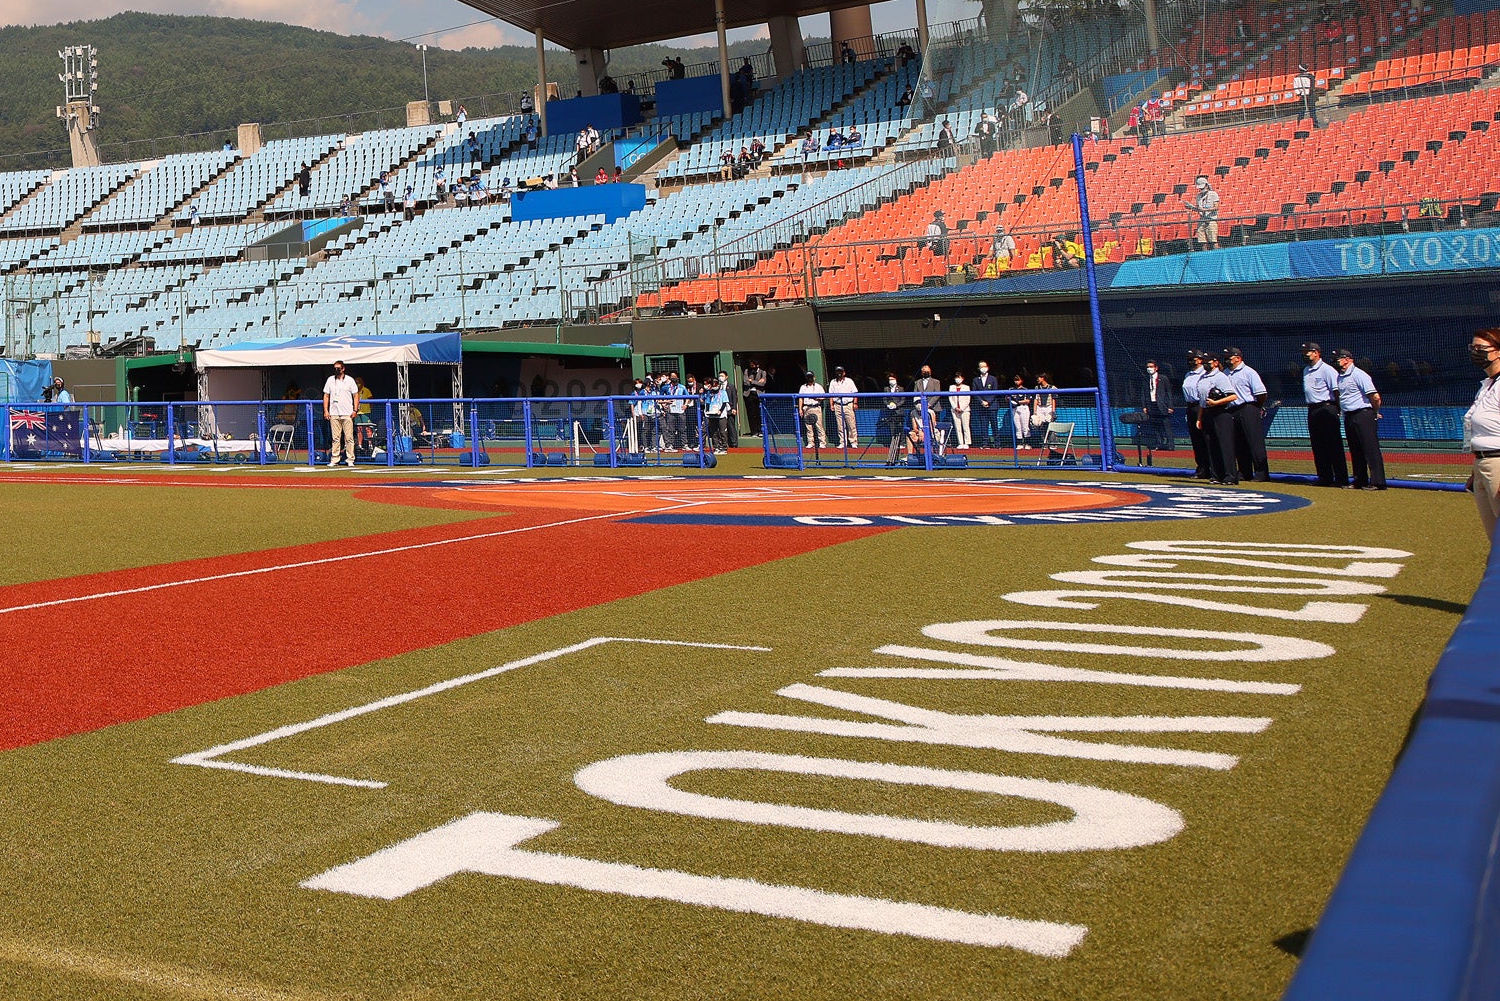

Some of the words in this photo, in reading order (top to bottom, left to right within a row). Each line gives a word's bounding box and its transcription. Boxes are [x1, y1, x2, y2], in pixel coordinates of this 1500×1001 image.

[1334, 237, 1443, 271] TOKYO
[298, 619, 1336, 958] TOKYO
[1001, 540, 1415, 624] 2020
